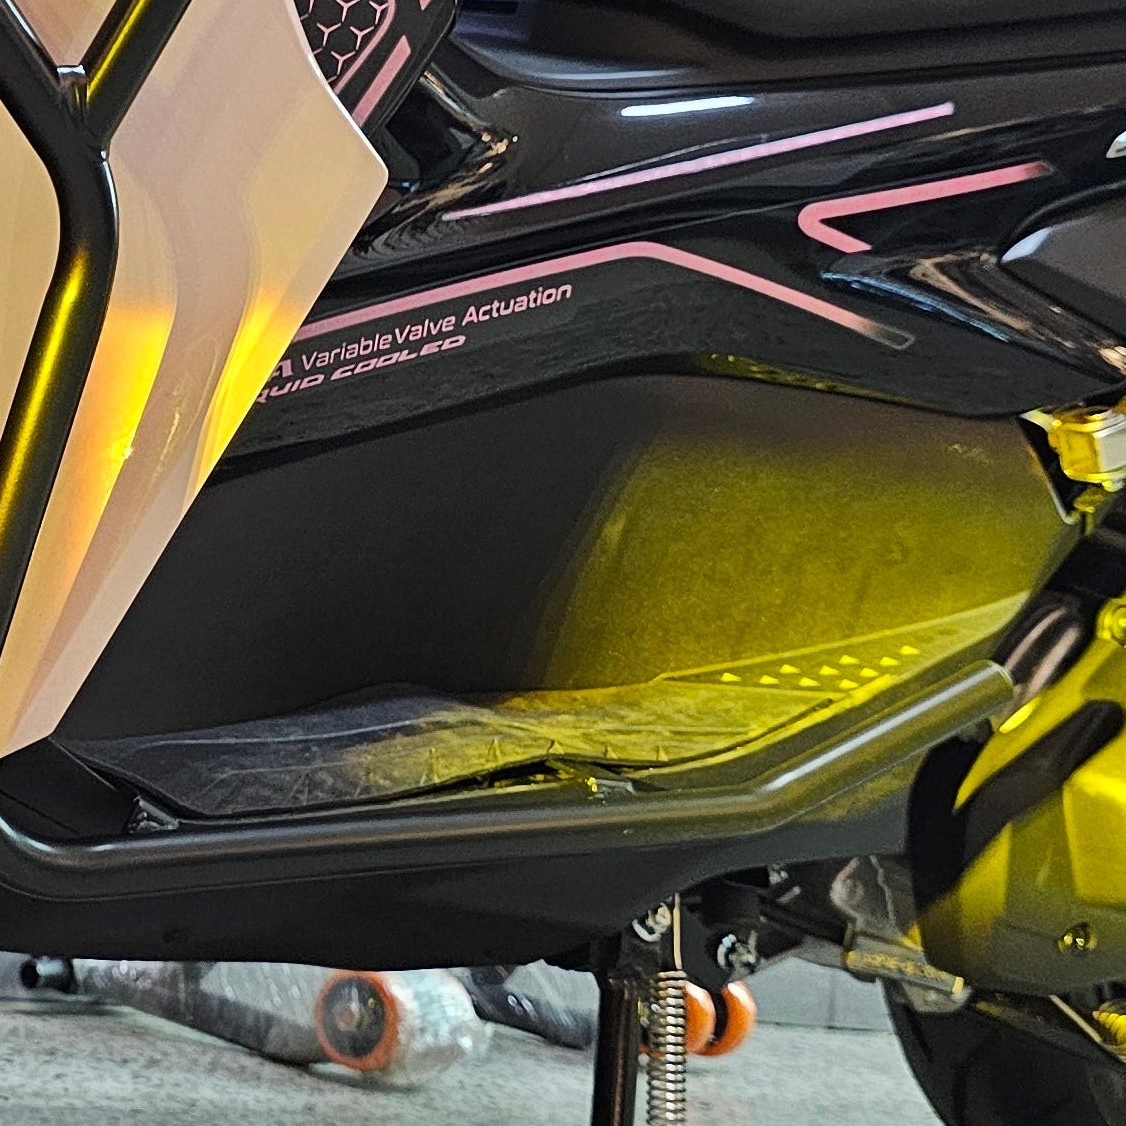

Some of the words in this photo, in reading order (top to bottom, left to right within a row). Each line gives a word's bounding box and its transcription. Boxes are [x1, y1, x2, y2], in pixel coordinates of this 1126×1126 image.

[301, 332, 393, 371] Variable
[394, 314, 456, 344] Valve
[462, 282, 573, 326] Actuation
[330, 334, 467, 381] COOLED
